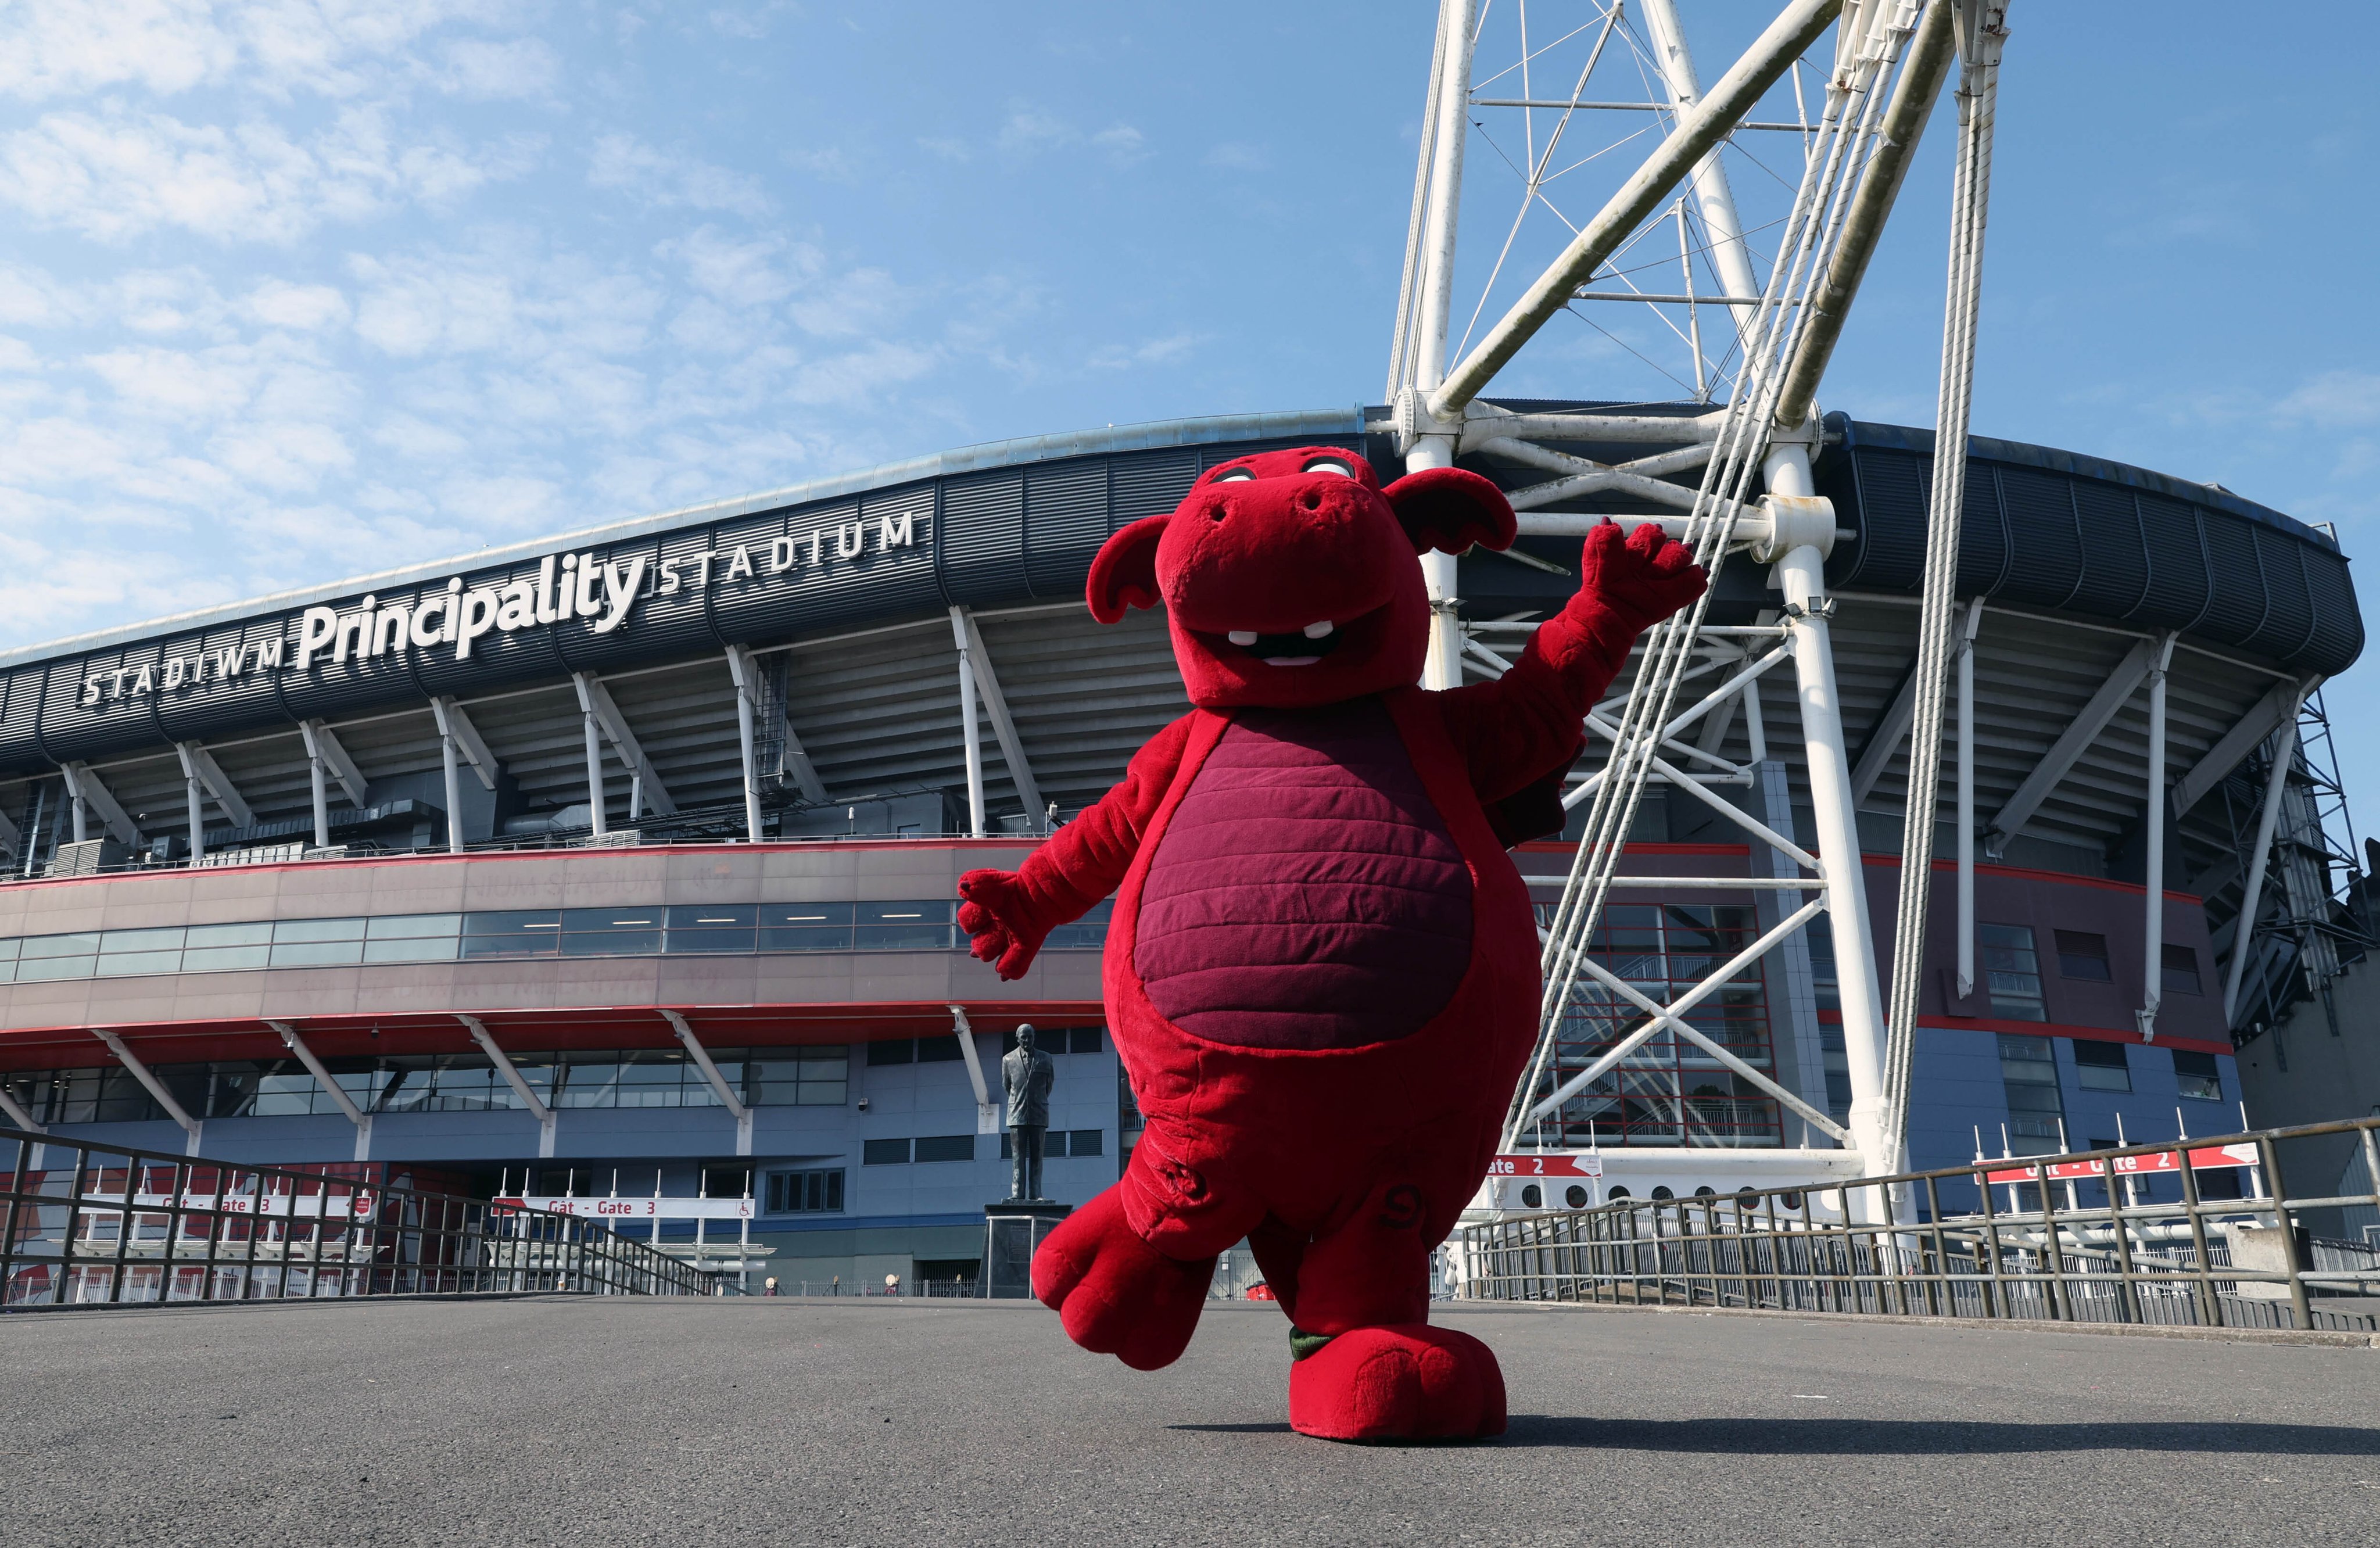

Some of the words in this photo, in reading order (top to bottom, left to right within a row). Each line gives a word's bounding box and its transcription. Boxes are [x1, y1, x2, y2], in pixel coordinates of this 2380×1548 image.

[83, 637, 285, 704] STADIWM
[296, 553, 647, 670] Principality
[659, 511, 914, 593] STADIUM
[1487, 1159, 1515, 1174] ate
[1533, 1158, 1544, 1174] 2
[2025, 1164, 2060, 1177] Gt
[2089, 1156, 2137, 1173] Gte
[2156, 1152, 2170, 1167] 2
[163, 1198, 188, 1208] Gt
[212, 1199, 246, 1212] ate
[261, 1199, 270, 1212] 3
[549, 1200, 574, 1214] Gât
[598, 1201, 632, 1214] Gate
[647, 1202, 655, 1214] 3
